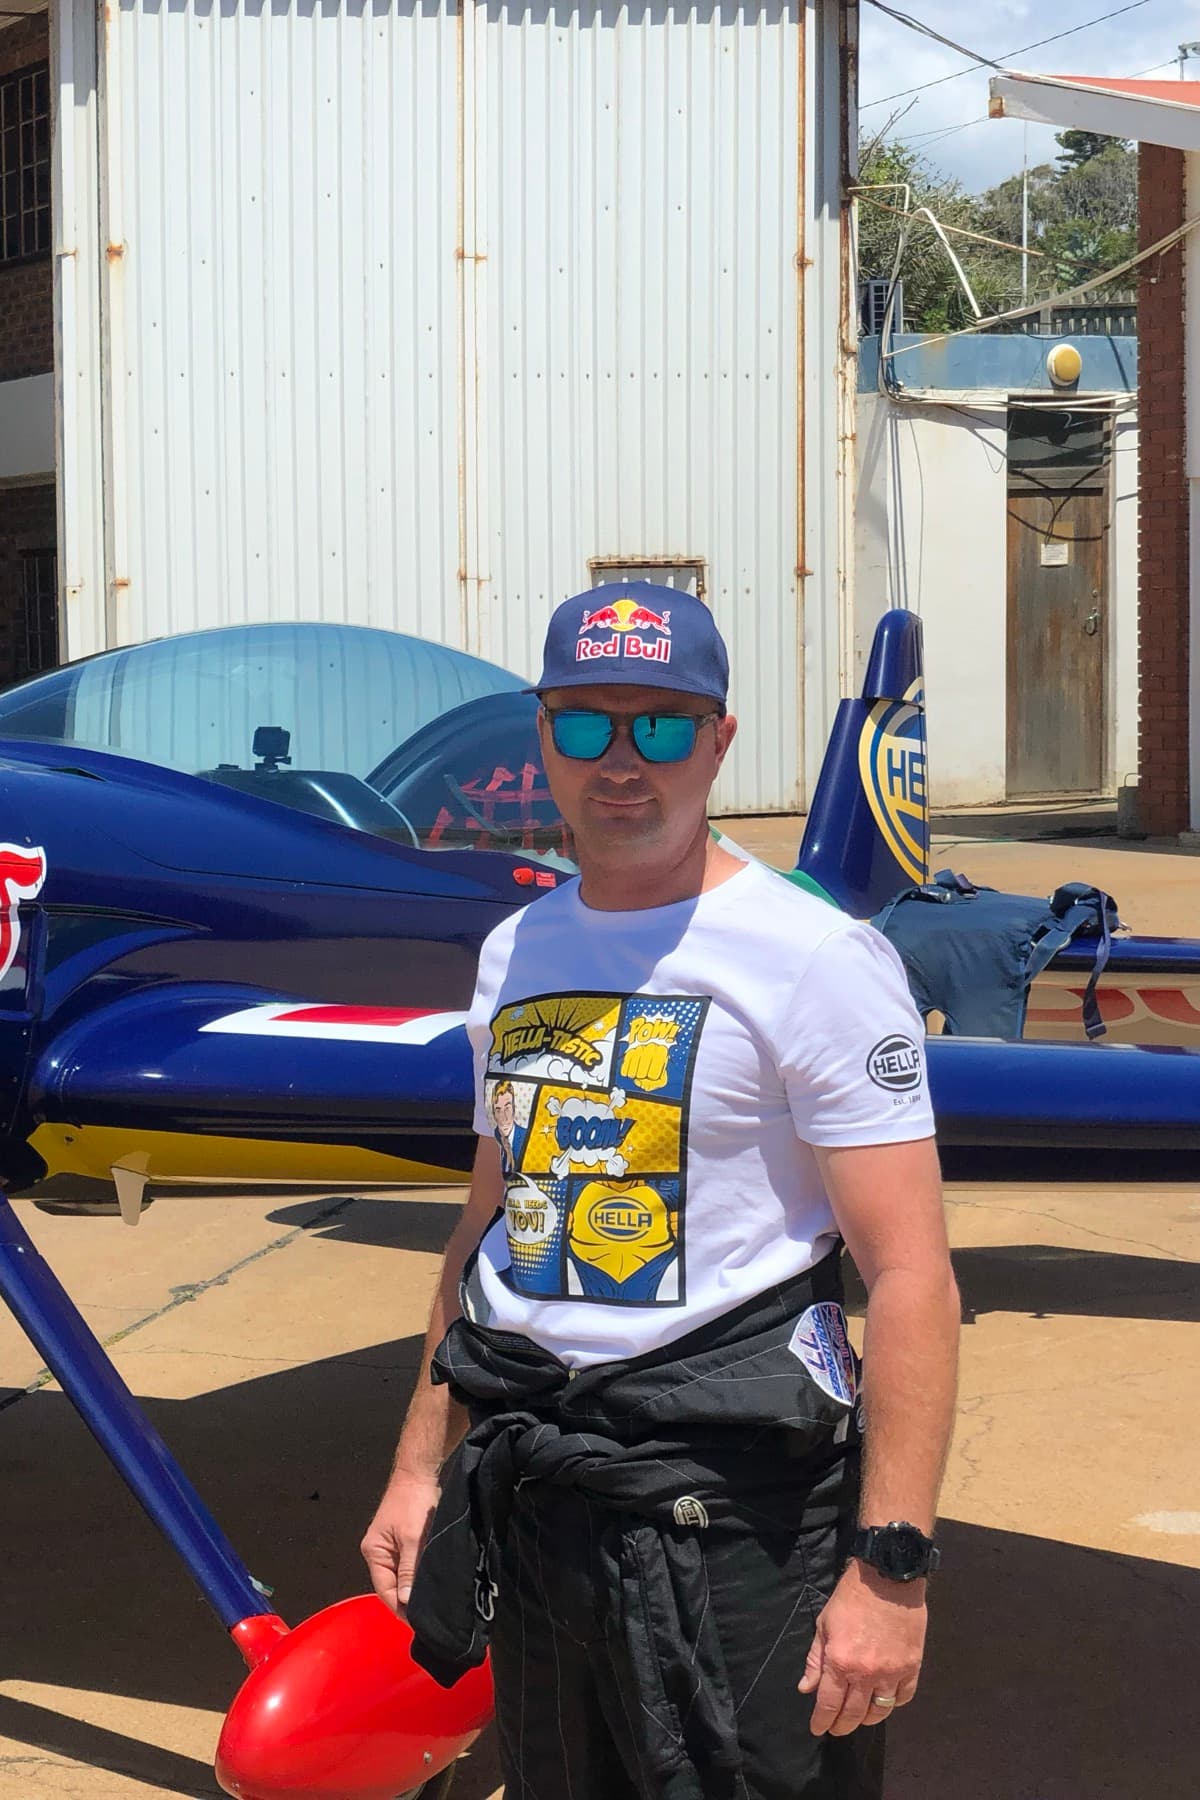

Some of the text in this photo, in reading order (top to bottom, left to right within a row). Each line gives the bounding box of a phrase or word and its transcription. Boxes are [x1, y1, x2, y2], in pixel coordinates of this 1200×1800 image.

[576, 633, 672, 663] Red Bull
[628, 1016, 682, 1045] POW!
[556, 1114, 637, 1151] BOOM!
[508, 1210, 545, 1233] YOU!
[594, 1212, 652, 1228] HELLA
